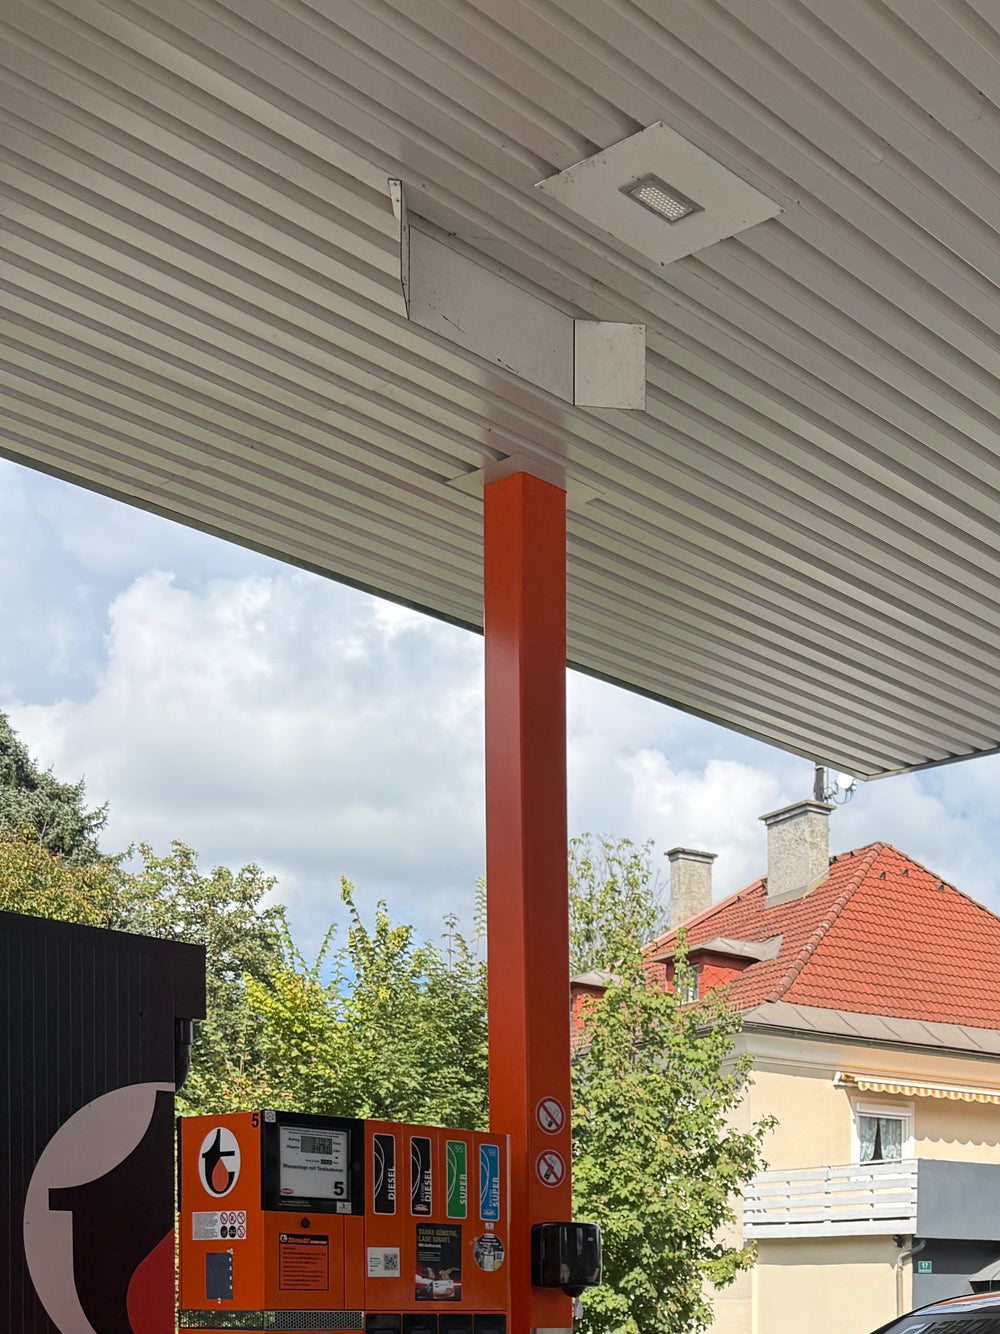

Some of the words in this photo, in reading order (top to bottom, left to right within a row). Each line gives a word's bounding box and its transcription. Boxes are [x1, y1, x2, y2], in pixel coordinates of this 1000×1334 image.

[251, 1112, 259, 1128] 5
[333, 1181, 344, 1196] 5
[387, 1166, 396, 1200] DIESEL
[424, 1168, 432, 1202] DIESEL
